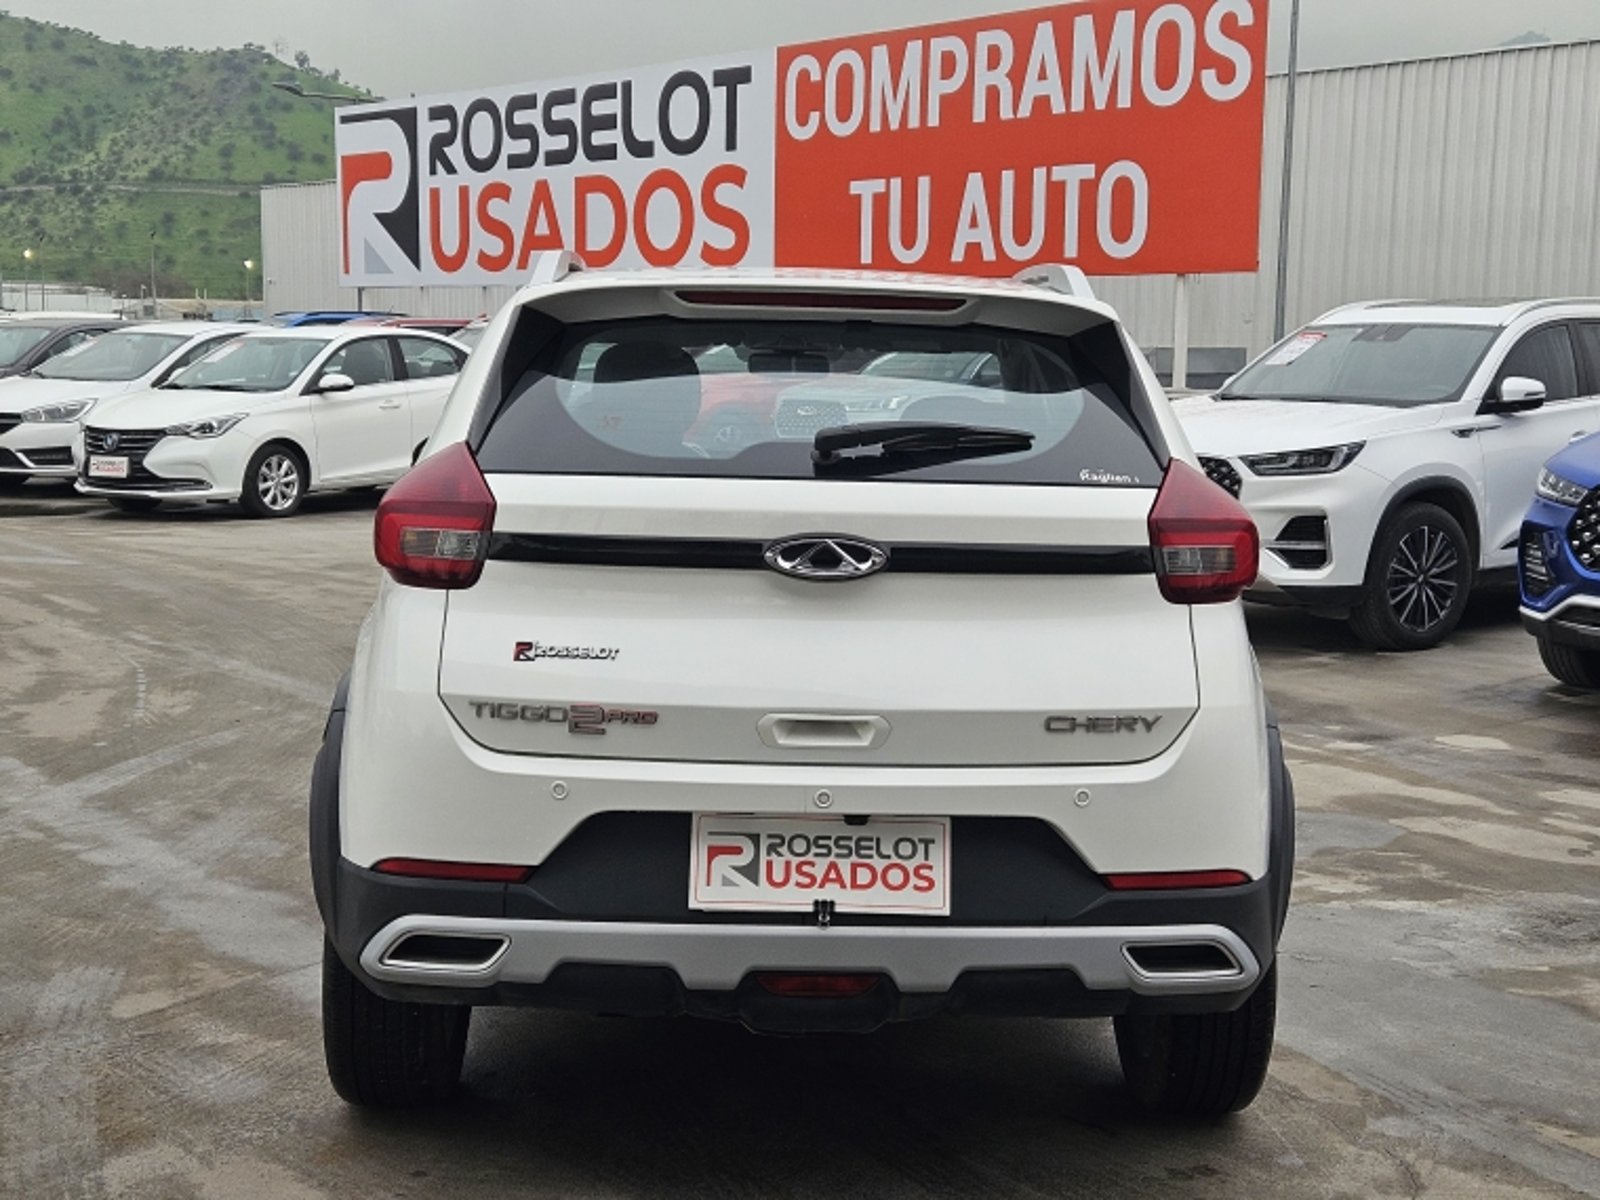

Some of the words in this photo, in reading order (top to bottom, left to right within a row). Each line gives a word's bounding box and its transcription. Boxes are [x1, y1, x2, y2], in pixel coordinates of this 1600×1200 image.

[784, 0, 1254, 140] COMPRAMOS
[428, 65, 752, 176] ROSSELOT
[429, 163, 751, 273] USADOS
[849, 176, 931, 264] TU
[950, 160, 1149, 263] AUTO
[469, 702, 568, 723] TIGGO
[568, 704, 606, 735] 2
[606, 709, 659, 725] PRO
[1044, 715, 1163, 733] CHERY
[766, 833, 936, 861] ROSSELOT
[766, 860, 936, 893] USADOS
